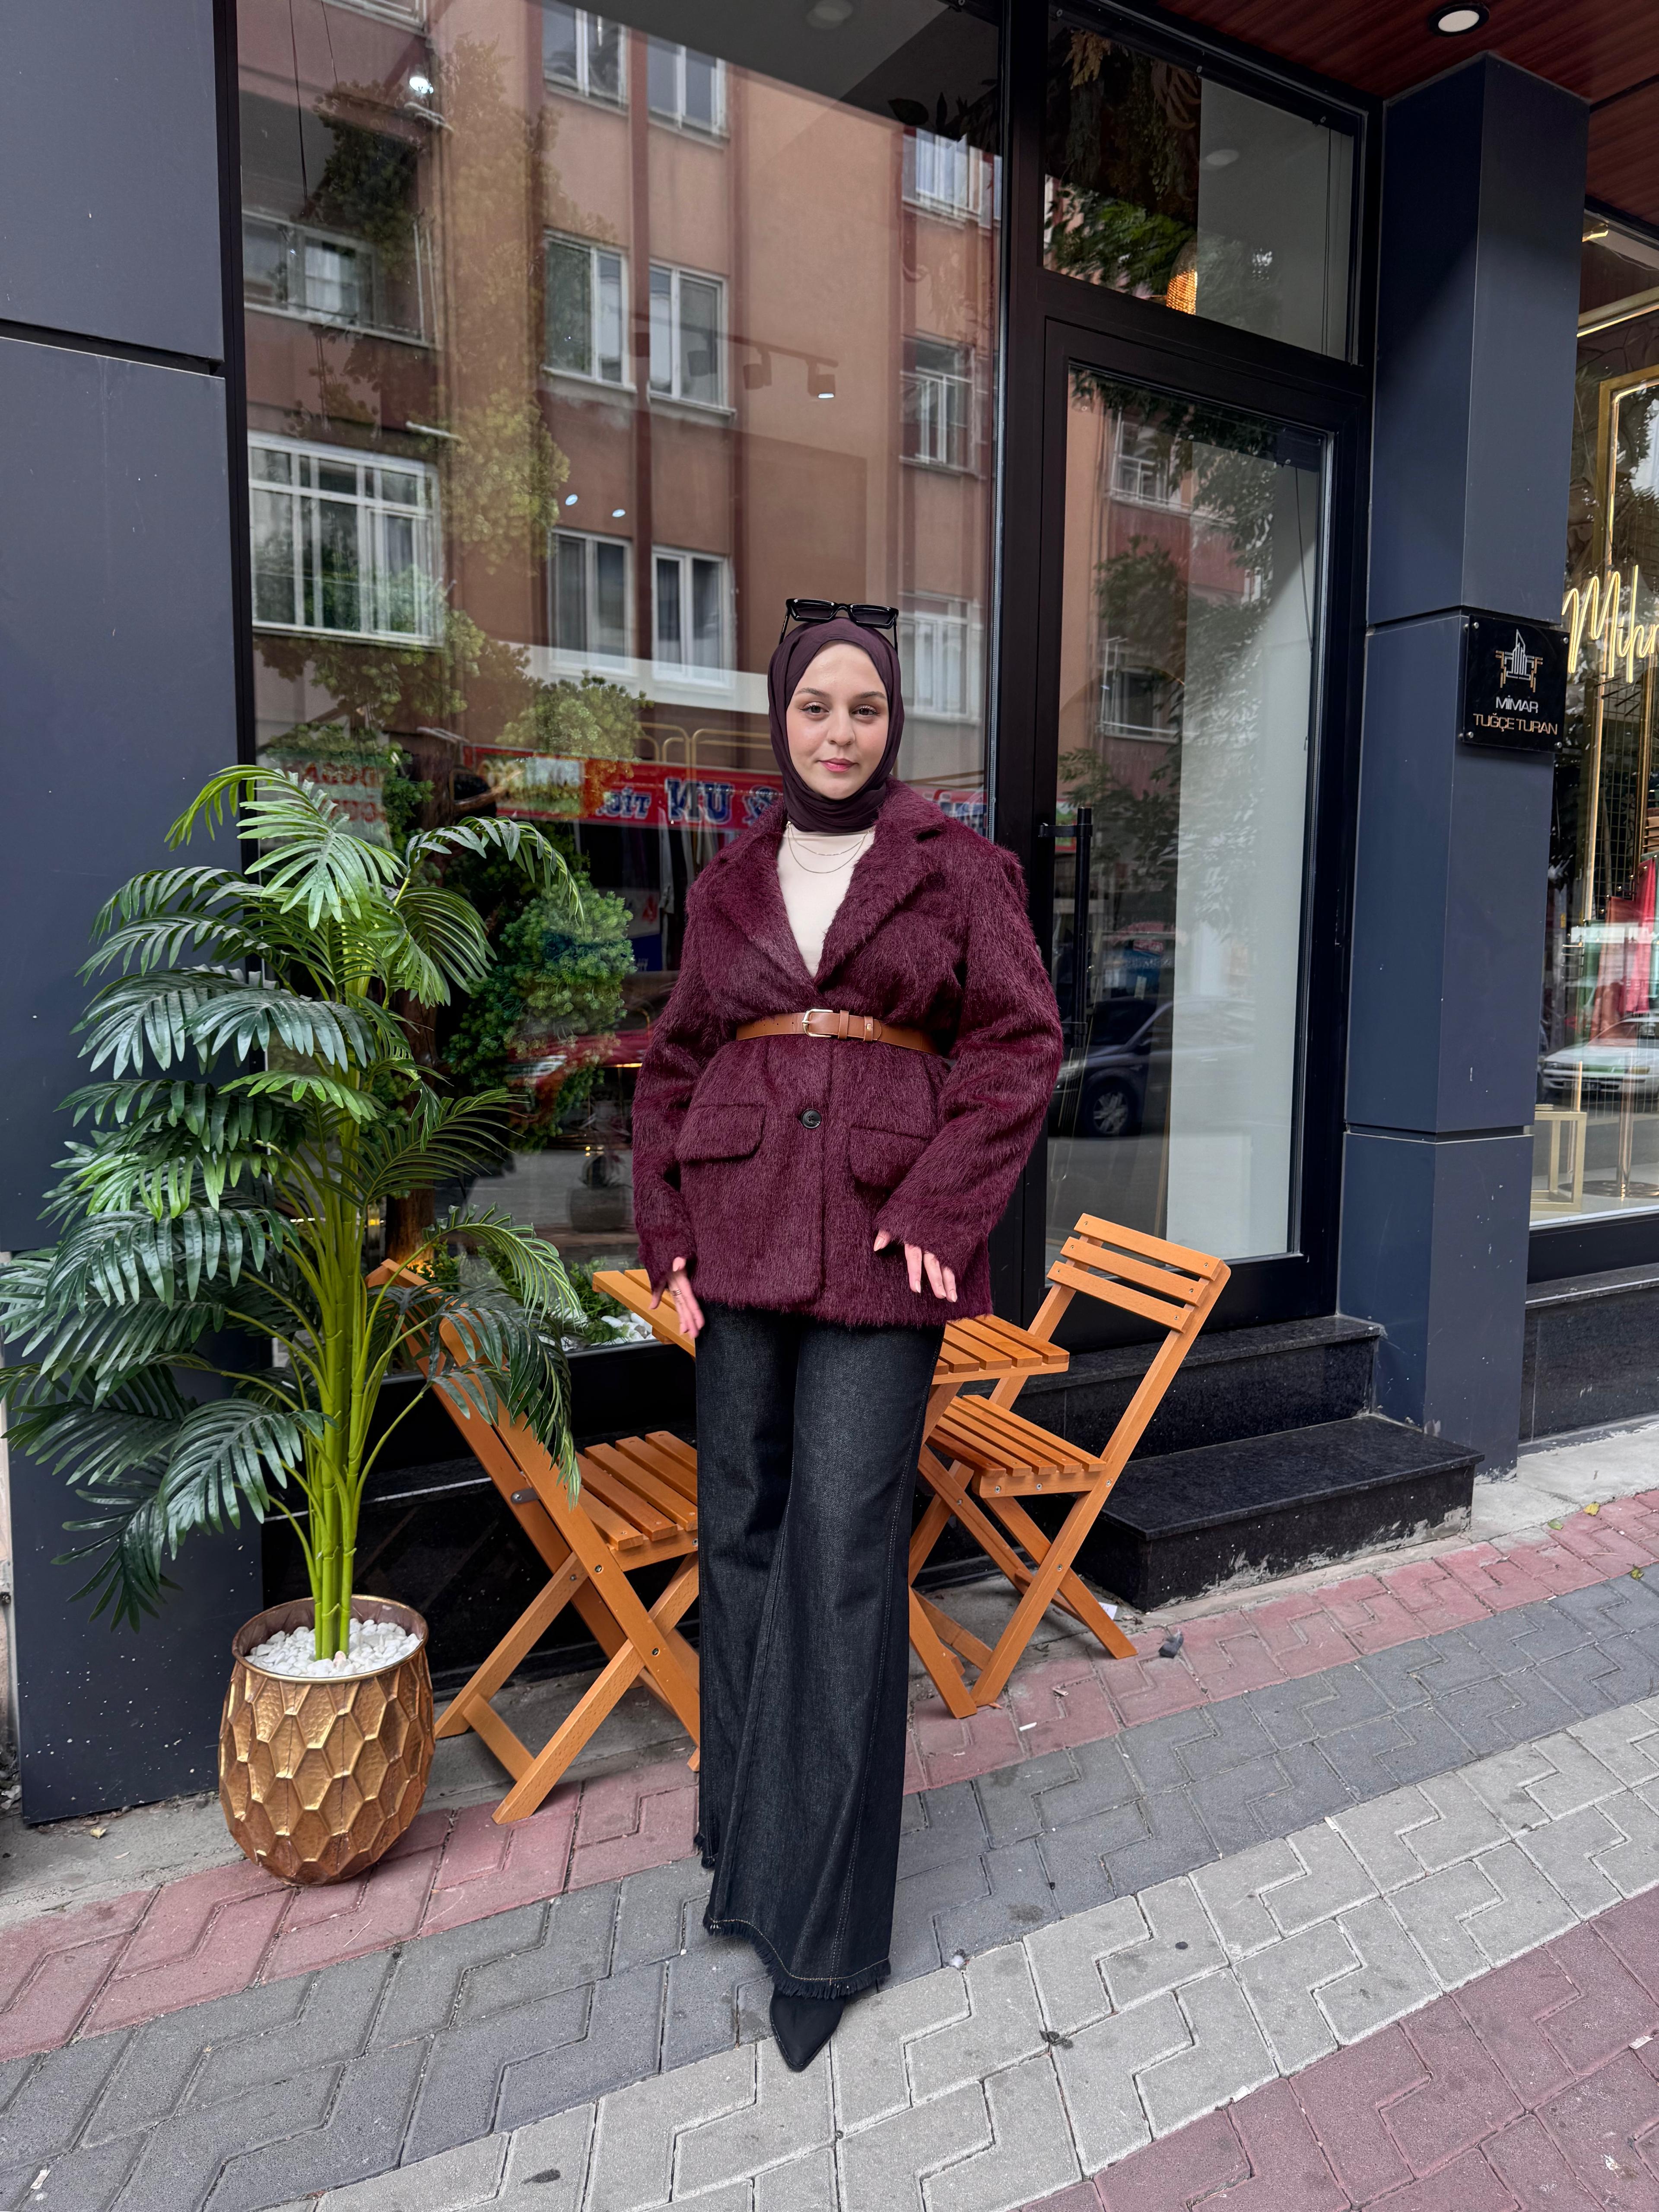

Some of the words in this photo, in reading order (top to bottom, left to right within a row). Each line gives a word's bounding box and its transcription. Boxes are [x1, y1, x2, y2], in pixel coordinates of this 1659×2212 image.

[1496, 695, 1538, 713] MİMAR
[1473, 712, 1515, 732] TUĞÇE
[1516, 718, 1558, 735] TURAN
